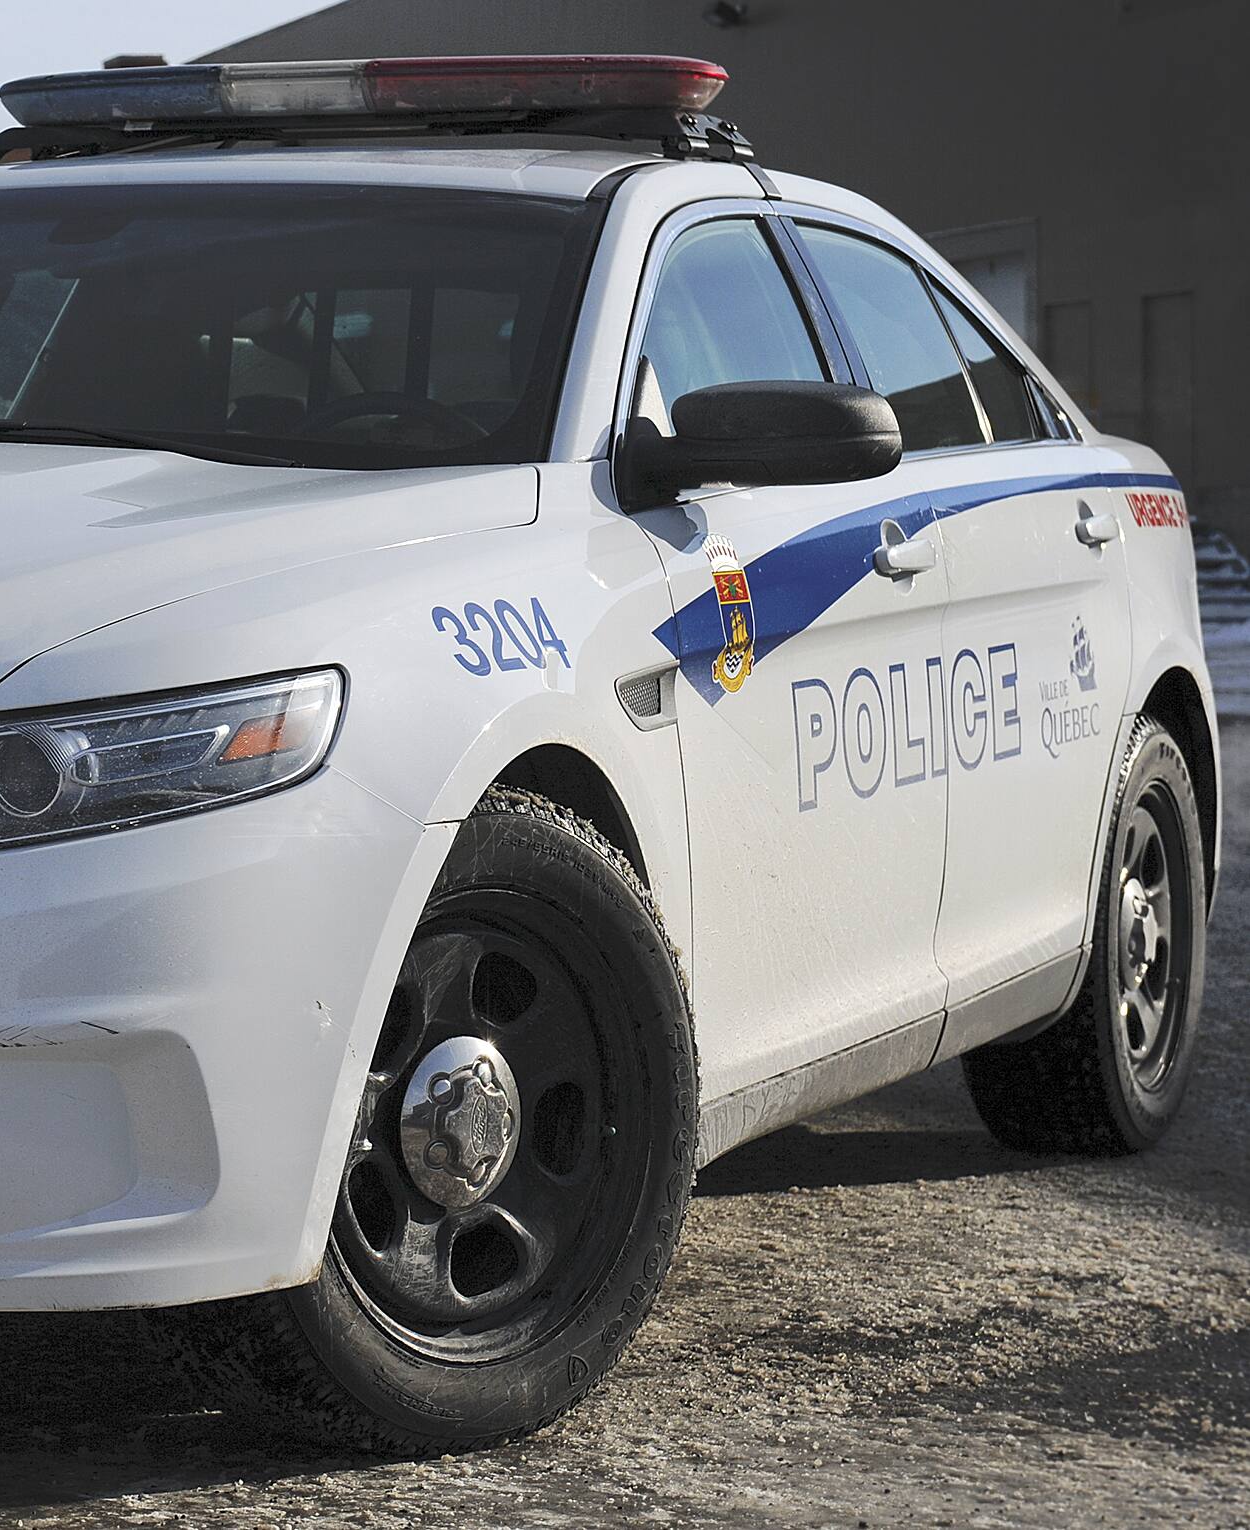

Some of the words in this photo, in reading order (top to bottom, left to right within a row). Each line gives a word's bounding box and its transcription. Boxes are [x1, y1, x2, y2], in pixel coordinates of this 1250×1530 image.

[431, 598, 572, 676] 3204
[791, 643, 1022, 813] POLICE
[1041, 701, 1100, 759] QUÉBEC
